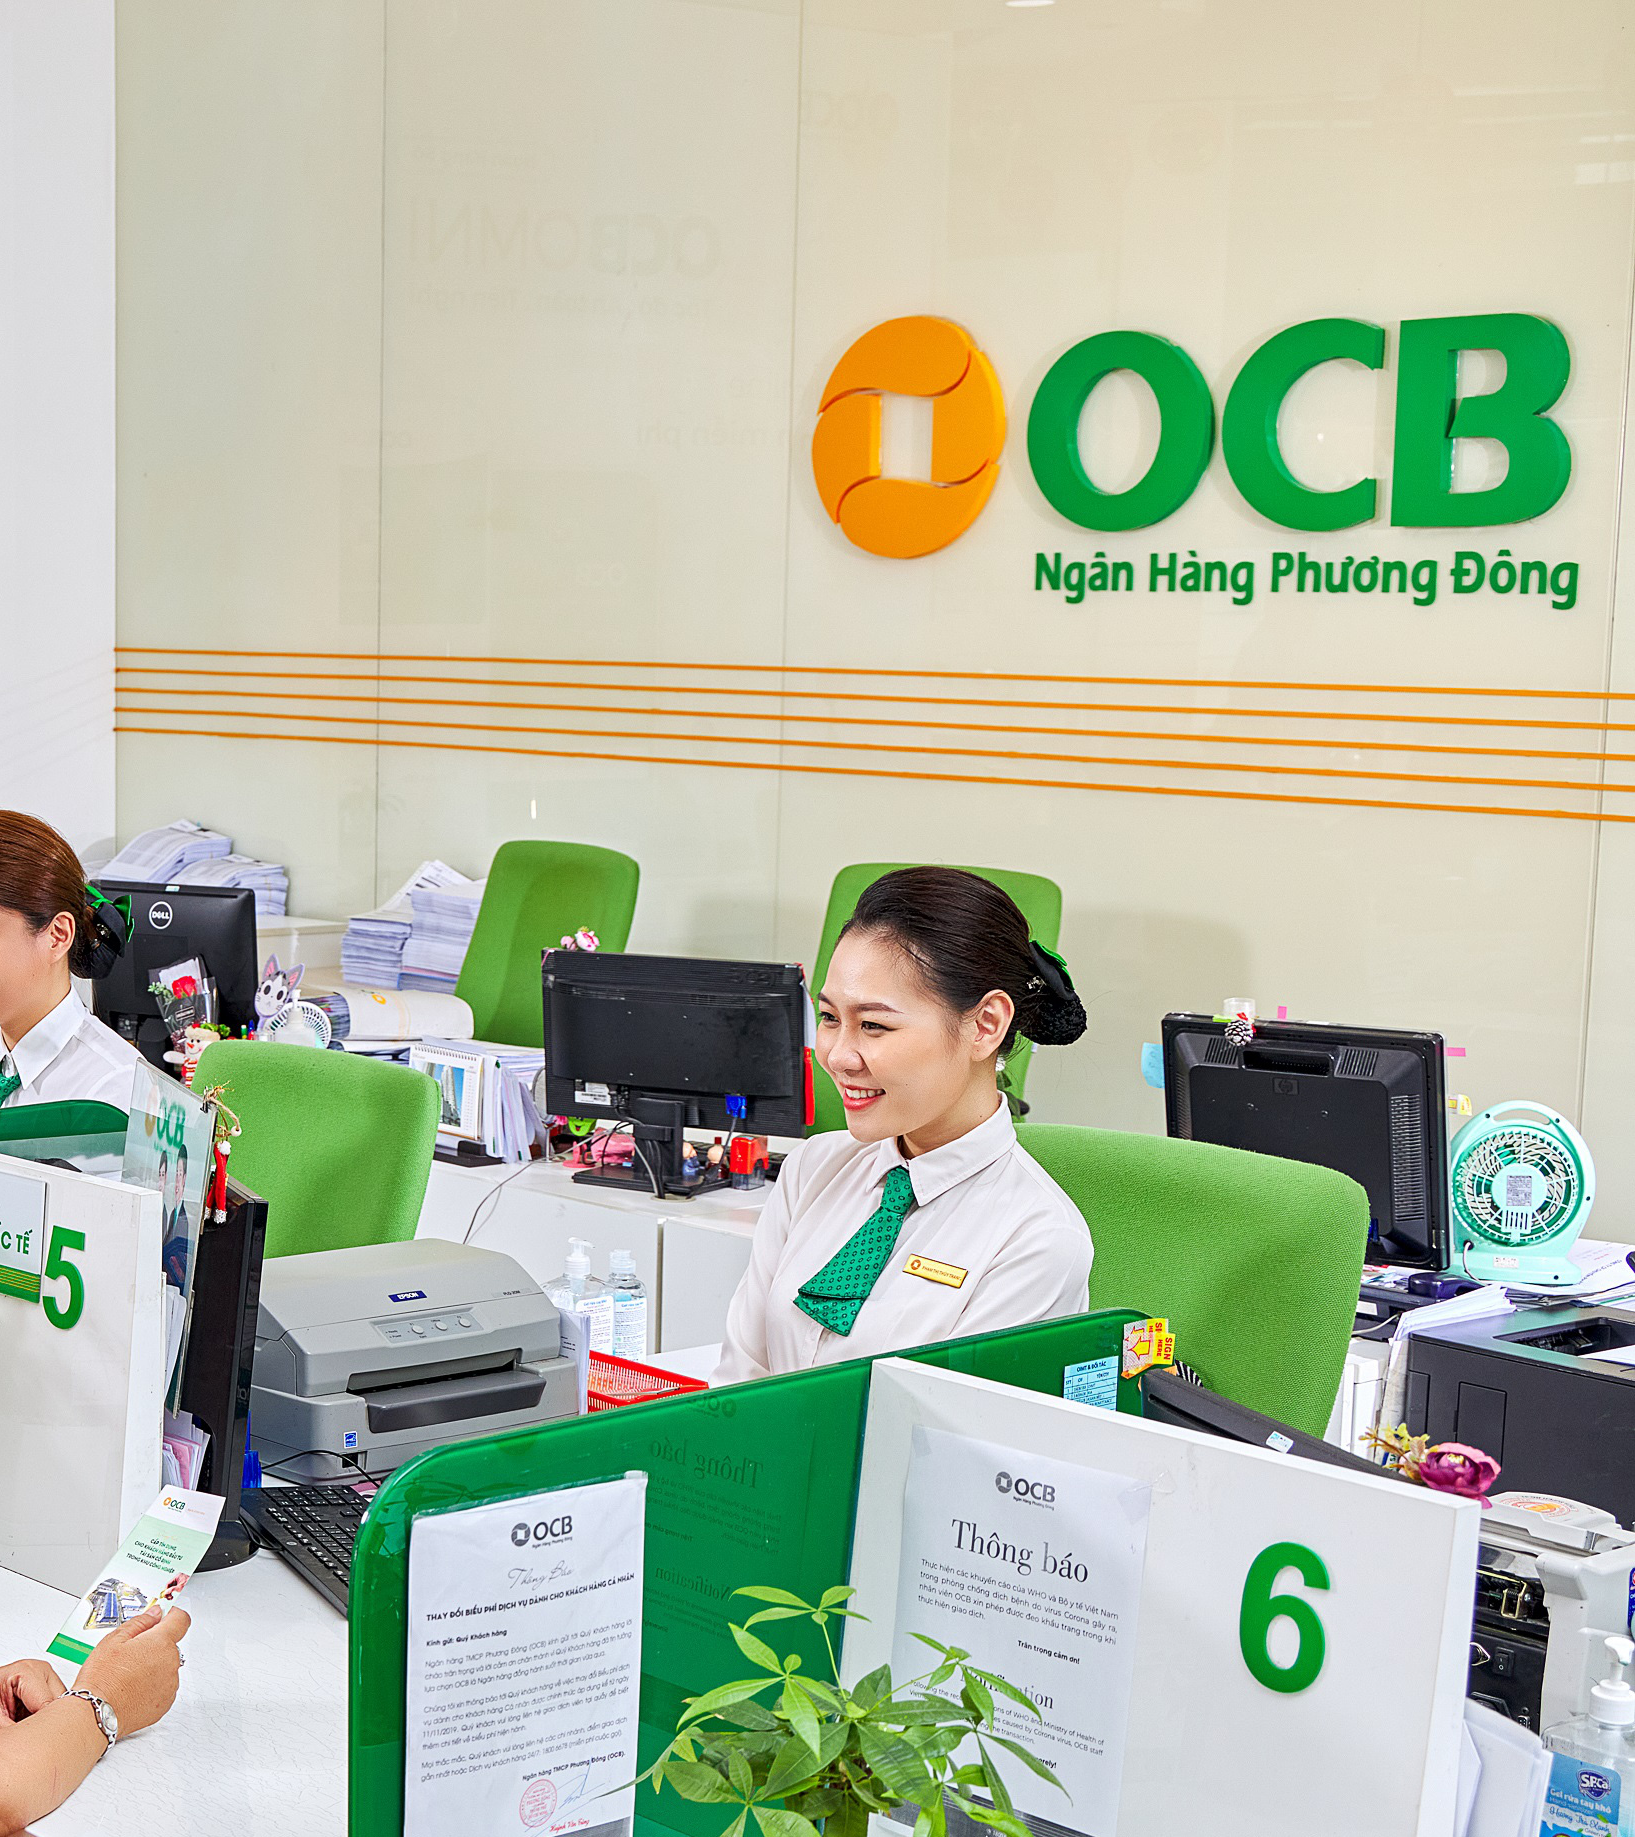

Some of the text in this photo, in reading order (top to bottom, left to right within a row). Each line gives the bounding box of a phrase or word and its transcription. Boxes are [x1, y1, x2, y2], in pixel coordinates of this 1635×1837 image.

[1027, 312, 1573, 533] OCB
[1034, 548, 1580, 611] Ngân Hàng Phương Đông
[151, 911, 170, 919] DELL
[16, 1229, 33, 1254] TẾ
[42, 1225, 86, 1330] 5
[397, 1291, 419, 1300] EPSON
[1163, 1337, 1173, 1360] SIGN
[1015, 1478, 1056, 1503] OCB
[533, 1515, 572, 1540] OCB
[952, 1519, 1088, 1582] Thông báo
[426, 1572, 634, 1621] THAY ĐỔI BIỂU PHÍ DỊCH VỤ DÀNH CHO KHÁCH HÀNG CÁ NHÂN
[920, 1571, 1117, 1633] trong phòng chống dịch bệnh do virus Corona gây ra,
[921, 1558, 937, 1569] Thực
[939, 1563, 955, 1574] hiện
[956, 1569, 968, 1578] các
[970, 1572, 996, 1585] khuyến
[997, 1581, 1011, 1589] cáo
[1012, 1584, 1025, 1593] của
[1027, 1588, 1047, 1599] WHO
[1058, 1596, 1068, 1606] Bộ
[1069, 1601, 1074, 1609] y
[1075, 1602, 1083, 1610] tế
[1084, 1604, 1098, 1614] Việt
[1100, 1608, 1118, 1619] Nam
[918, 1595, 987, 1620] thực hiện giao dịch.
[919, 1583, 1116, 1645] nhân viên OCB xin phép được đeo khẩu trang trong khi
[1239, 1541, 1331, 1693] 6
[1017, 1640, 1080, 1664] Trân trọng cảm ơn!
[1550, 1788, 1563, 1798] Gel
